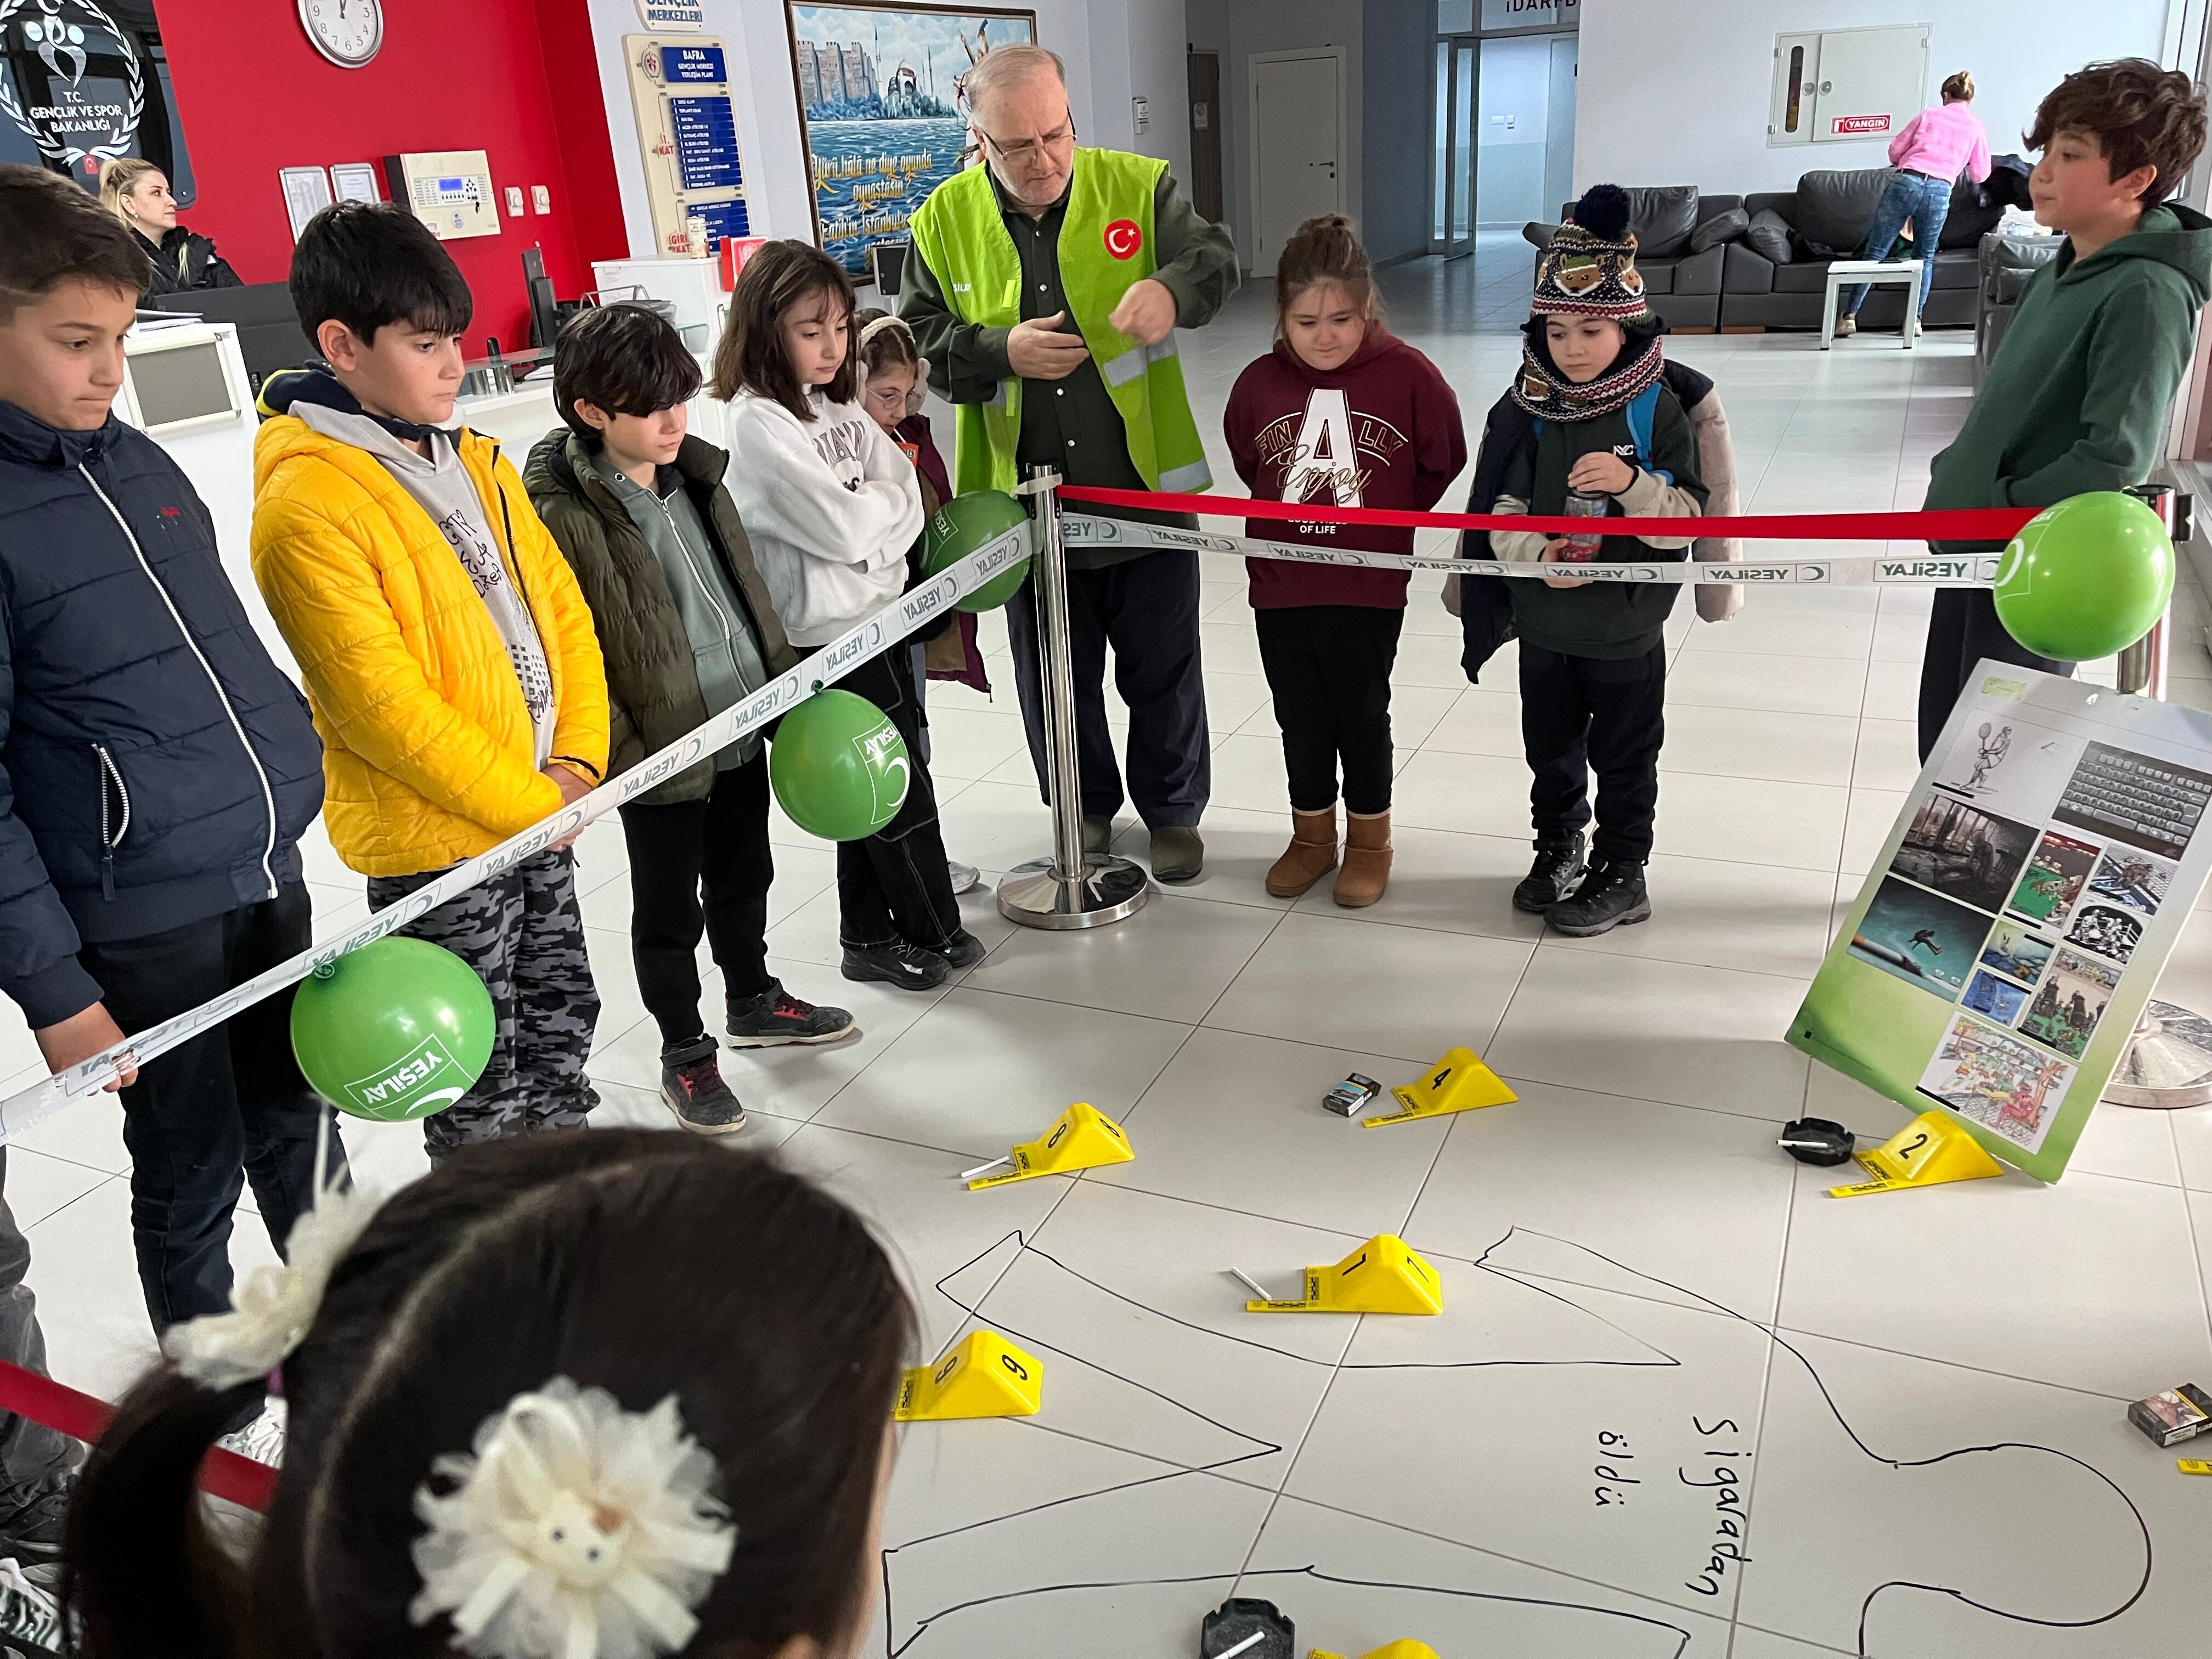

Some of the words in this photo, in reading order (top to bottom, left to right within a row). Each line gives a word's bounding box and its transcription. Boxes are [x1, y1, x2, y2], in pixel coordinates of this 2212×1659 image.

[313, 5, 320, 16] 9
[364, 7, 370, 18] 3
[320, 23, 327, 33] 8
[363, 24, 369, 35] 4
[332, 36, 337, 46] 7
[345, 41, 352, 51] 6
[357, 36, 363, 46] 5
[682, 50, 706, 60] BAFRA
[63, 91, 84, 103] T.C.
[80, 105, 94, 117] VE
[94, 104, 123, 117] SPOR
[50, 117, 111, 133] BAKANLIĞI
[1849, 120, 1885, 128] YANGIN
[659, 145, 674, 155] KAT
[865, 157, 876, 174] ne
[1277, 443, 1372, 504] Enjoy
[1300, 525, 1313, 533] OF
[1316, 526, 1336, 534] LIFE
[1432, 1068, 1452, 1091] 4
[1099, 1118, 1121, 1138] 8
[1048, 1123, 1067, 1149] 8
[1899, 1133, 1928, 1160] 2
[1594, 1431, 1641, 1506] öldü
